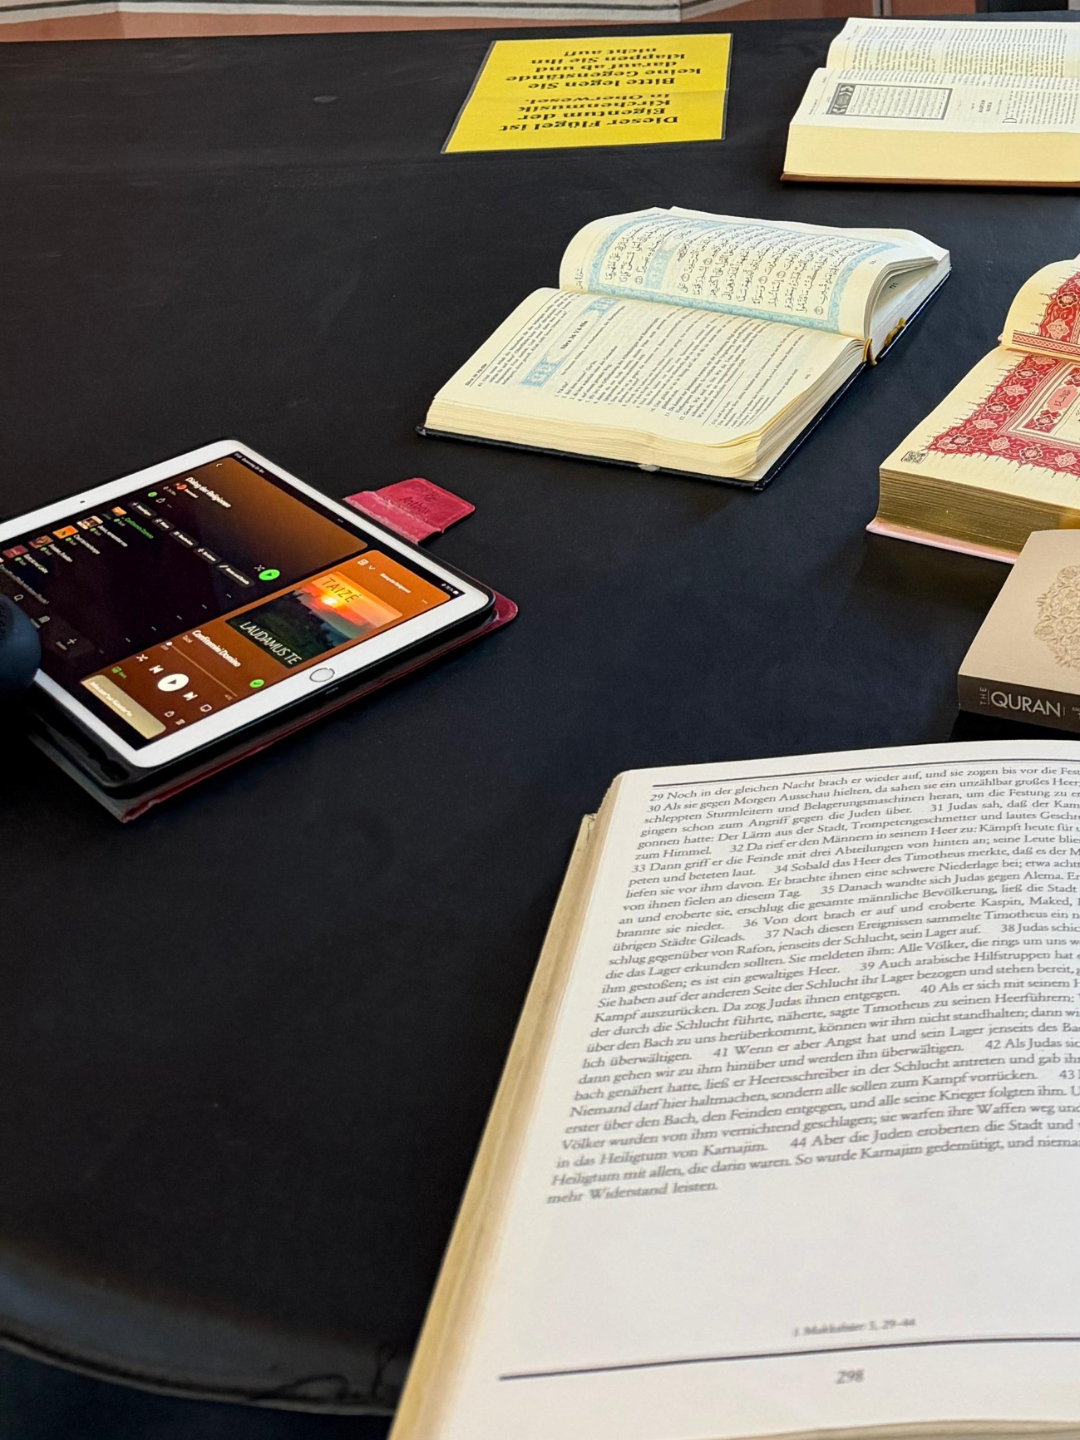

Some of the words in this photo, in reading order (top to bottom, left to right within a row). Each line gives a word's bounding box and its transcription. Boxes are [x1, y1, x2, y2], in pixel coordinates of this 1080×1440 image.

[608, 61, 677, 69] darauf
[506, 70, 639, 81] Gegenstände
[528, 82, 559, 90] Sie
[565, 80, 620, 88] legen
[518, 100, 670, 112] Kirchenmusik
[563, 108, 666, 118] Eigentum
[499, 124, 528, 132] ist
[534, 120, 600, 130] Flügel
[606, 116, 678, 125] Dieser
[322, 578, 362, 603] TAIZÉ
[239, 621, 290, 656] LAUDAMUS
[284, 654, 302, 665] TE
[991, 691, 1061, 718] QURAN
[650, 792, 663, 801] 29
[666, 789, 696, 799] Noch
[701, 788, 710, 797] in
[715, 787, 730, 796] der
[734, 783, 778, 796] gleichen
[782, 779, 814, 789] Nacht
[818, 776, 847, 786] brach
[865, 772, 899, 782] wieder
[902, 770, 921, 779] auf,
[926, 768, 946, 777] und
[950, 768, 963, 776] sie
[966, 768, 998, 777] zogen
[1002, 766, 1016, 774] bis
[1041, 766, 1056, 775] die
[644, 813, 701, 824] schleppten
[705, 807, 773, 819] Sturmleitern
[778, 803, 799, 813] und
[804, 794, 924, 811] Belagerungsmaschinen
[929, 792, 961, 801] heran,
[989, 789, 1004, 797] die
[1009, 788, 1050, 799] Festung
[637, 839, 679, 851] gonnen
[684, 835, 713, 844] hatte:
[717, 833, 737, 841] Der
[742, 830, 770, 839] Lärm
[796, 826, 813, 834] der
[816, 823, 847, 833] Stadt,
[852, 815, 976, 830] Trompetengeschmetter
[981, 812, 1002, 821] und
[1006, 811, 1036, 820] lautes
[593, 1010, 638, 1023] Kampf
[640, 1005, 718, 1019] auszurücken.
[722, 1002, 741, 1012] Da
[744, 1002, 765, 1011] zog
[768, 997, 801, 1011] Judas
[805, 994, 840, 1005] ihnen
[844, 990, 899, 1002] entgegen.
[920, 983, 935, 994] 40
[939, 982, 959, 992] Als
[976, 978, 1000, 989] sich
[1004, 978, 1024, 988] mit
[1027, 977, 1070, 987] seinem
[552, 1171, 620, 1186] Heiligtum
[623, 1167, 646, 1178] mit
[688, 1162, 708, 1173] die
[711, 1159, 746, 1171] darin
[795, 1153, 812, 1164] So
[816, 1150, 856, 1162] wurde
[860, 1144, 922, 1159] Karnajim
[1008, 1137, 1034, 1148] und
[546, 1191, 582, 1203] mehr
[590, 1183, 668, 1200] Widerstand
[836, 1369, 865, 1384] 298
